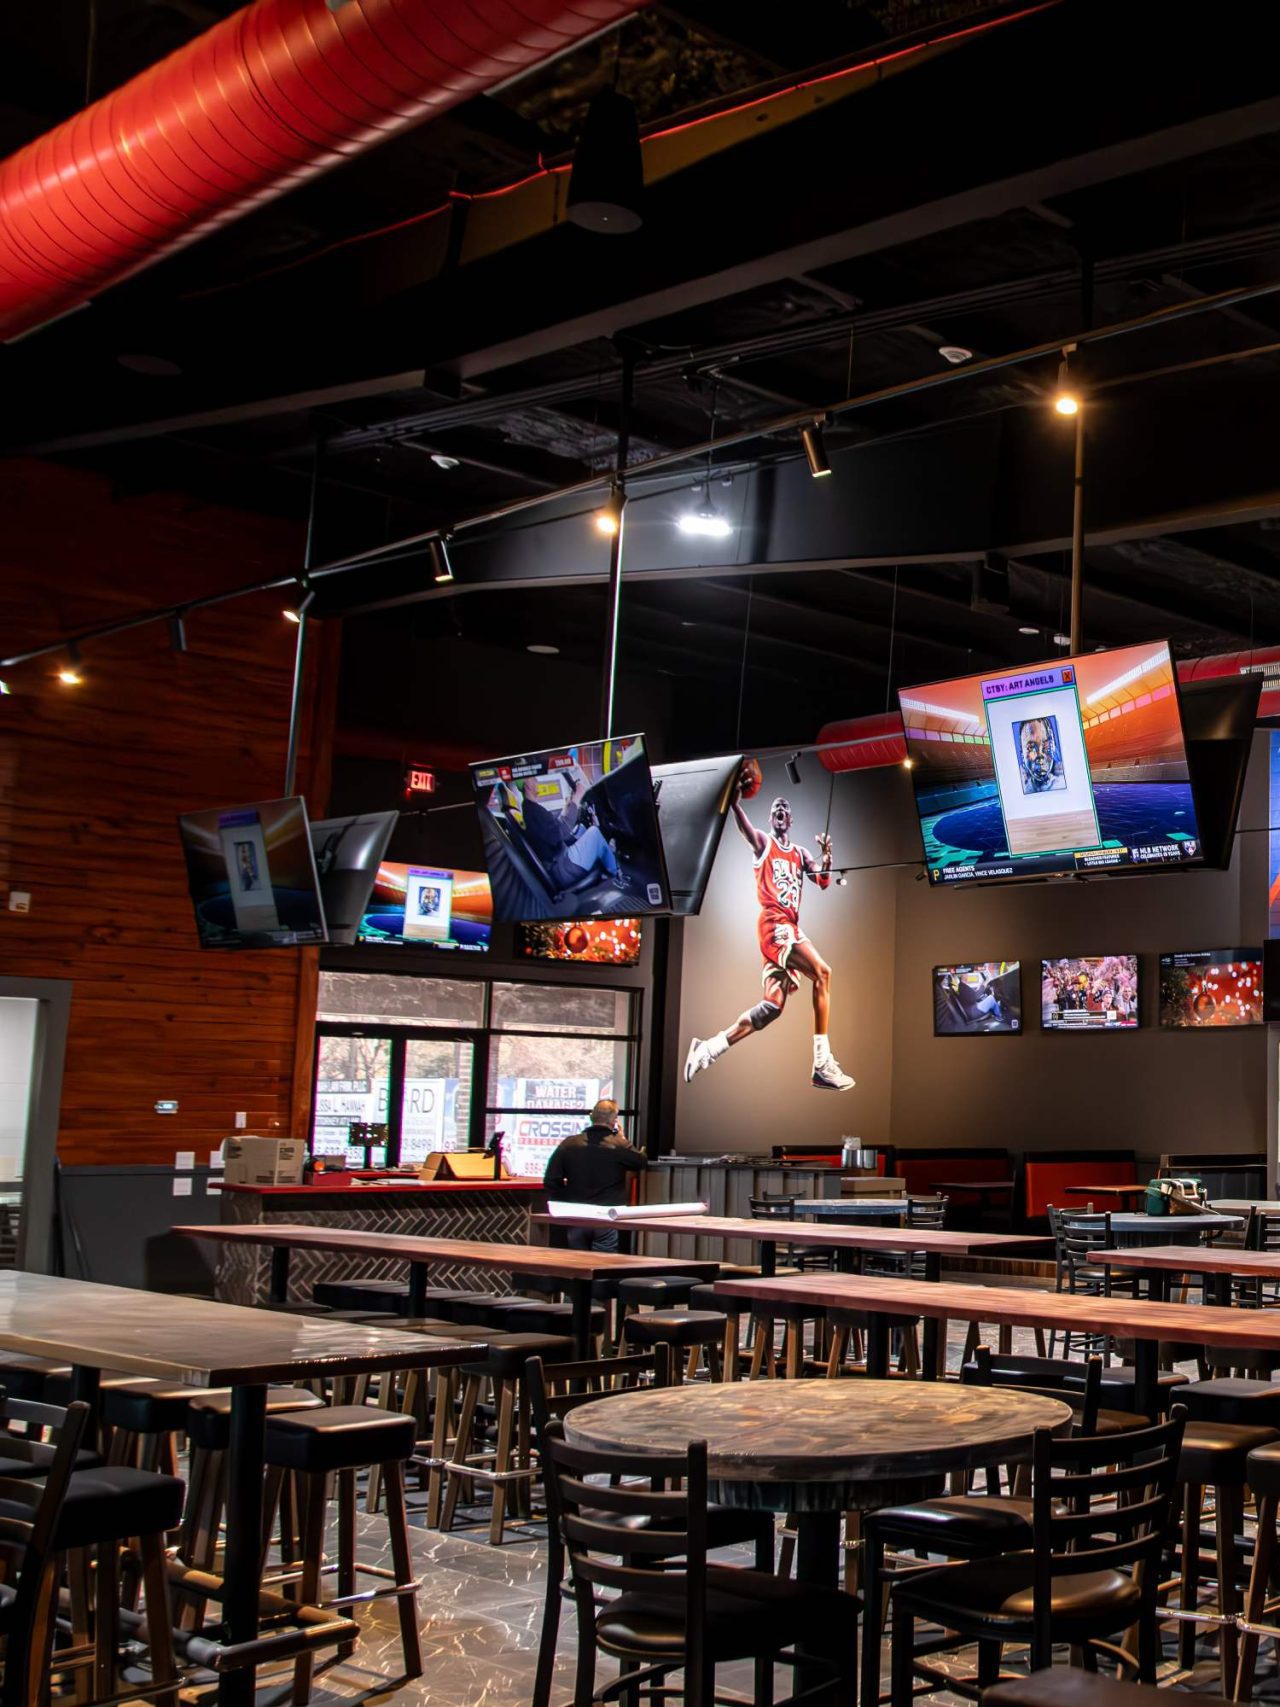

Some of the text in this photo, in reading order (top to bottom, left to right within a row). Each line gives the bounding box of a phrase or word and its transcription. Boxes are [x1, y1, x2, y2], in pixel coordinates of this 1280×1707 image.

[1009, 680, 1023, 690] ART
[1152, 843, 1180, 853] NETWORK
[535, 1085, 577, 1098] WATER
[519, 1120, 589, 1138] CROSSIN
